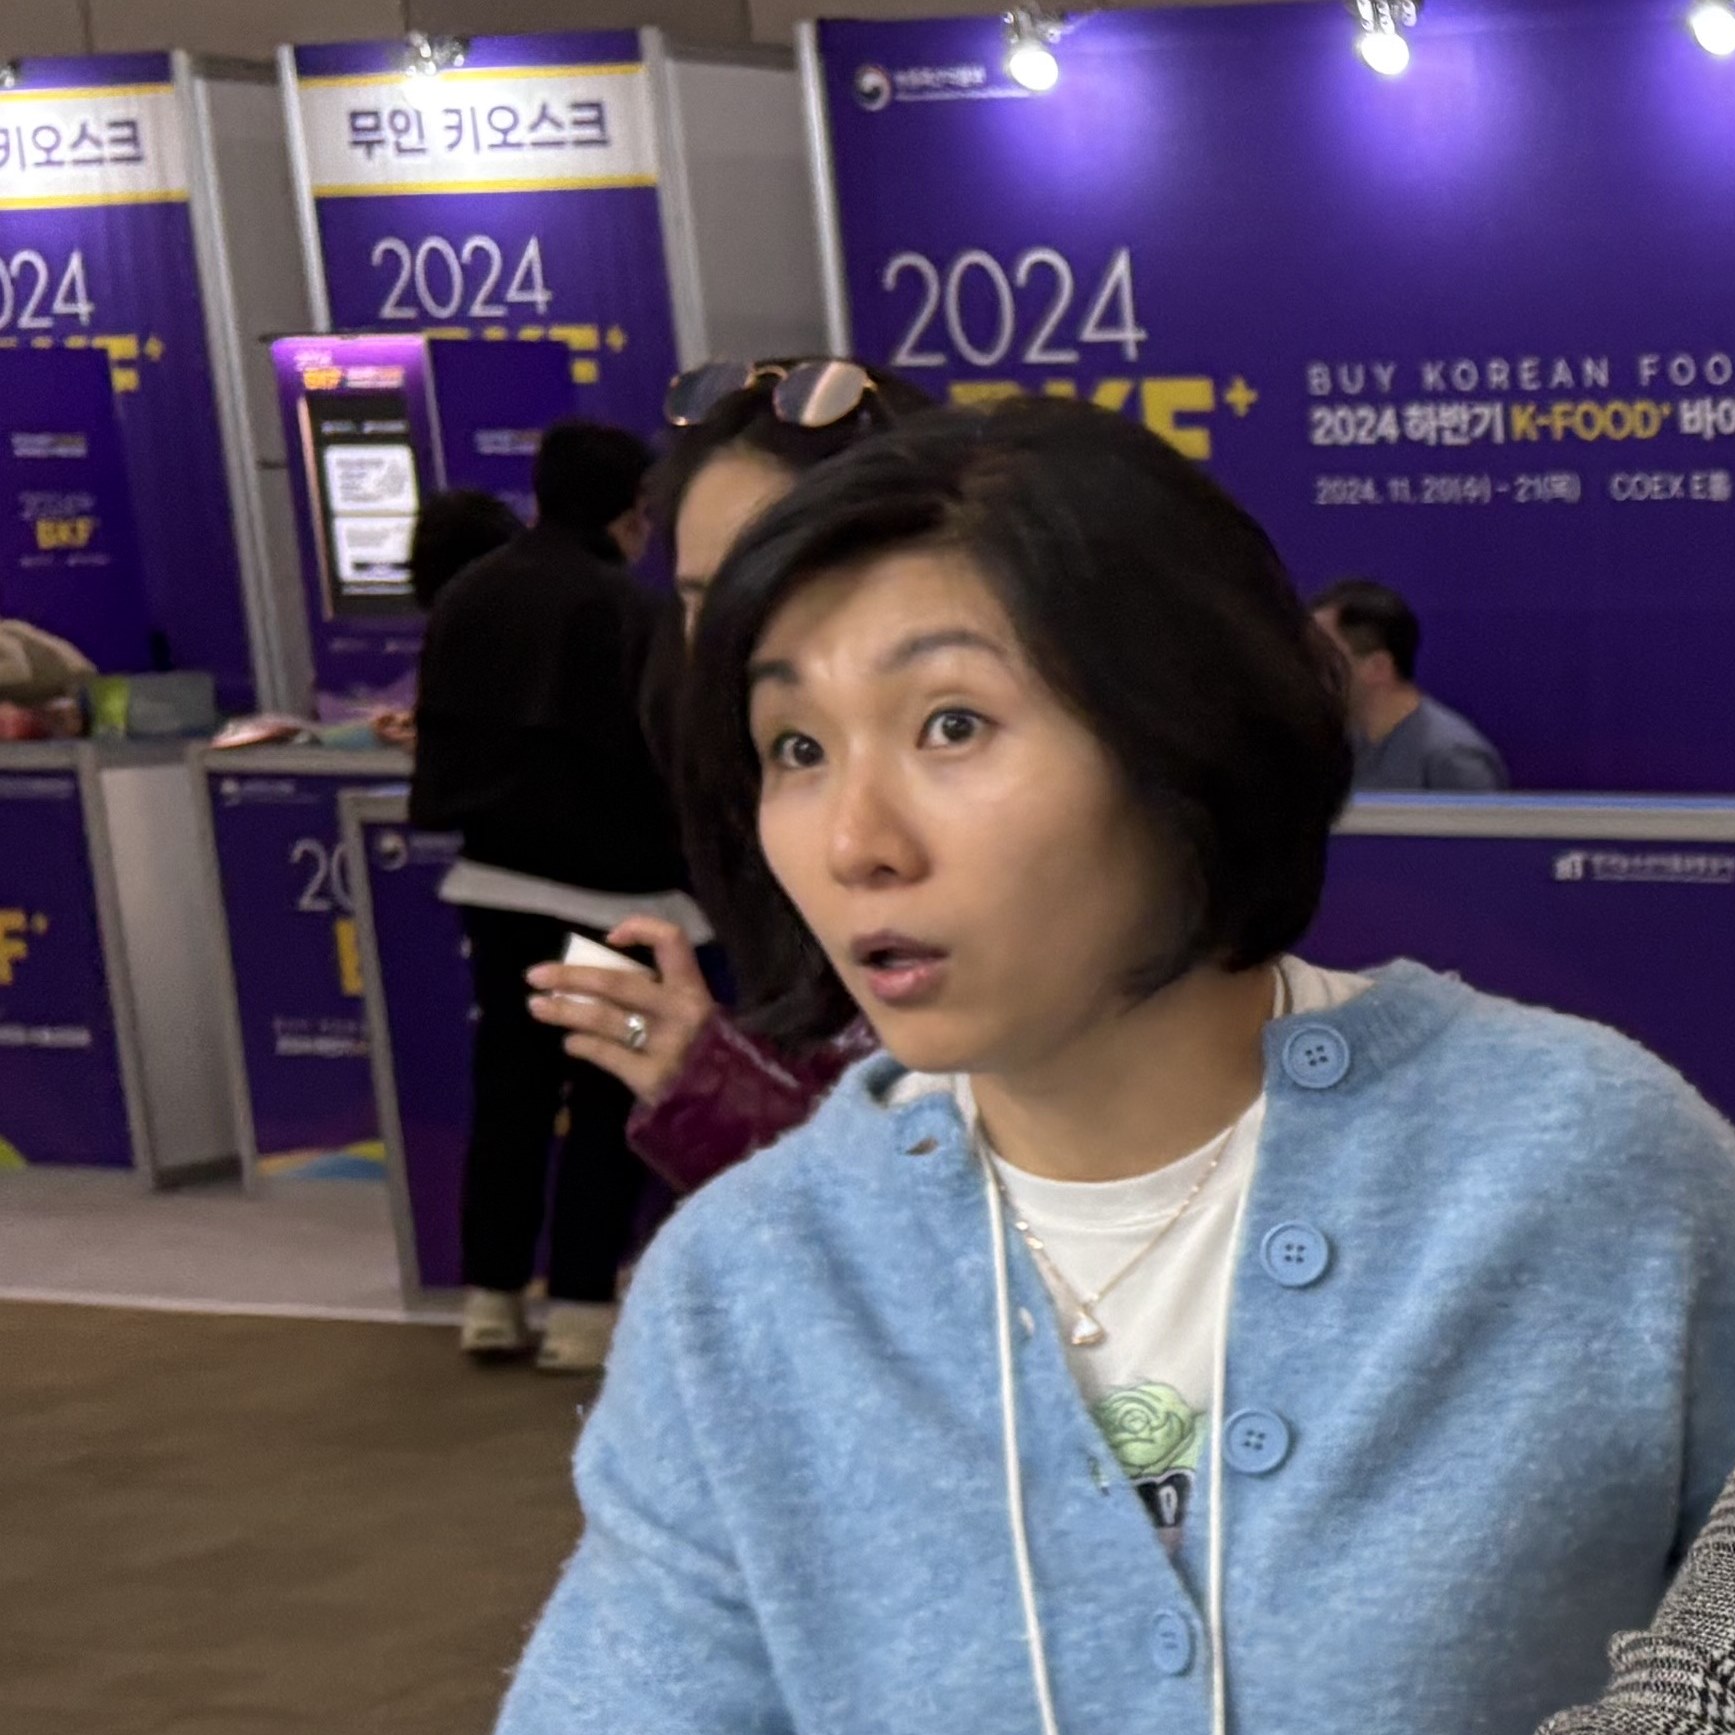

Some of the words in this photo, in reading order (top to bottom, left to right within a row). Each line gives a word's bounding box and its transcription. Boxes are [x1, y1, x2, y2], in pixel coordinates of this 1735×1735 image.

[348, 108, 428, 155] 무인
[443, 98, 611, 154] 키오스크
[369, 235, 554, 320] 2024
[882, 246, 1147, 367] 2024
[1306, 361, 1396, 396] BUY
[1422, 356, 1611, 392] KOREAN
[1309, 402, 1400, 446] 2024
[1402, 400, 1506, 447] 하반기
